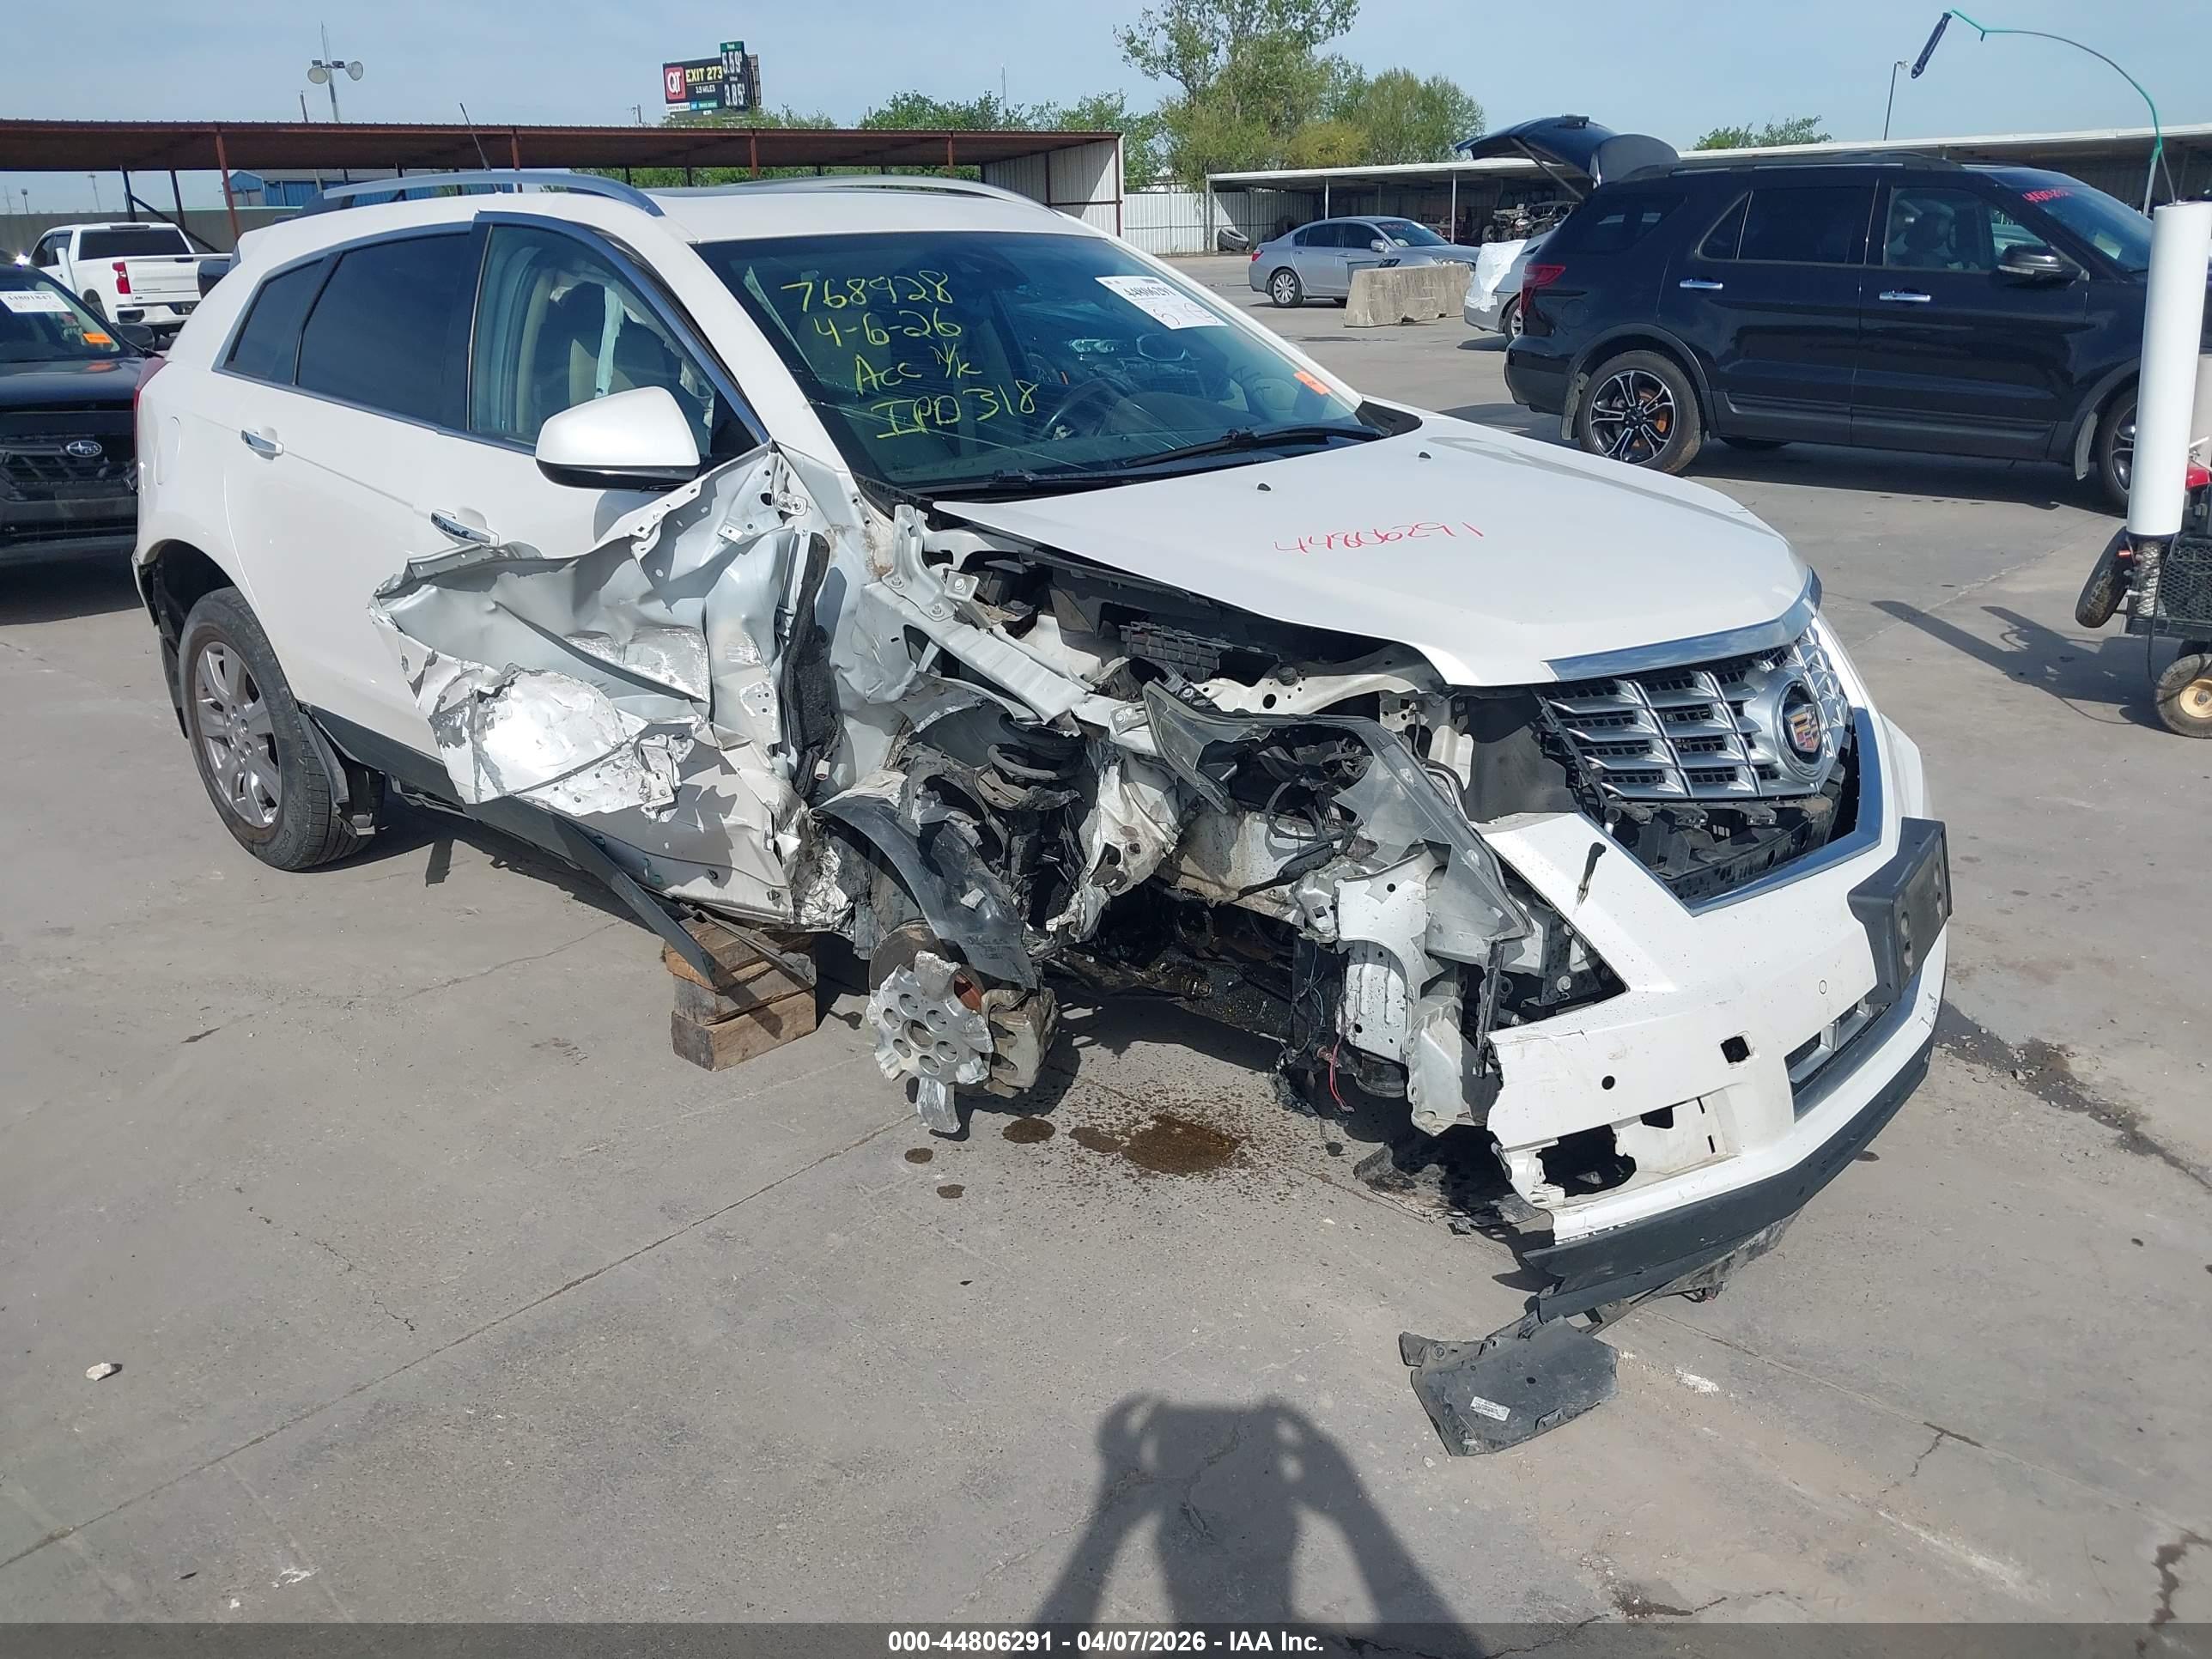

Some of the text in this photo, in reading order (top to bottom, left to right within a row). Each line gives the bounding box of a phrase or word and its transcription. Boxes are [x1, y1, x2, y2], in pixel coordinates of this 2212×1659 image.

[667, 71, 681, 95] QT
[685, 65, 723, 82] EXIT 273
[781, 270, 953, 312] 768928
[813, 307, 963, 347] 4-6-26
